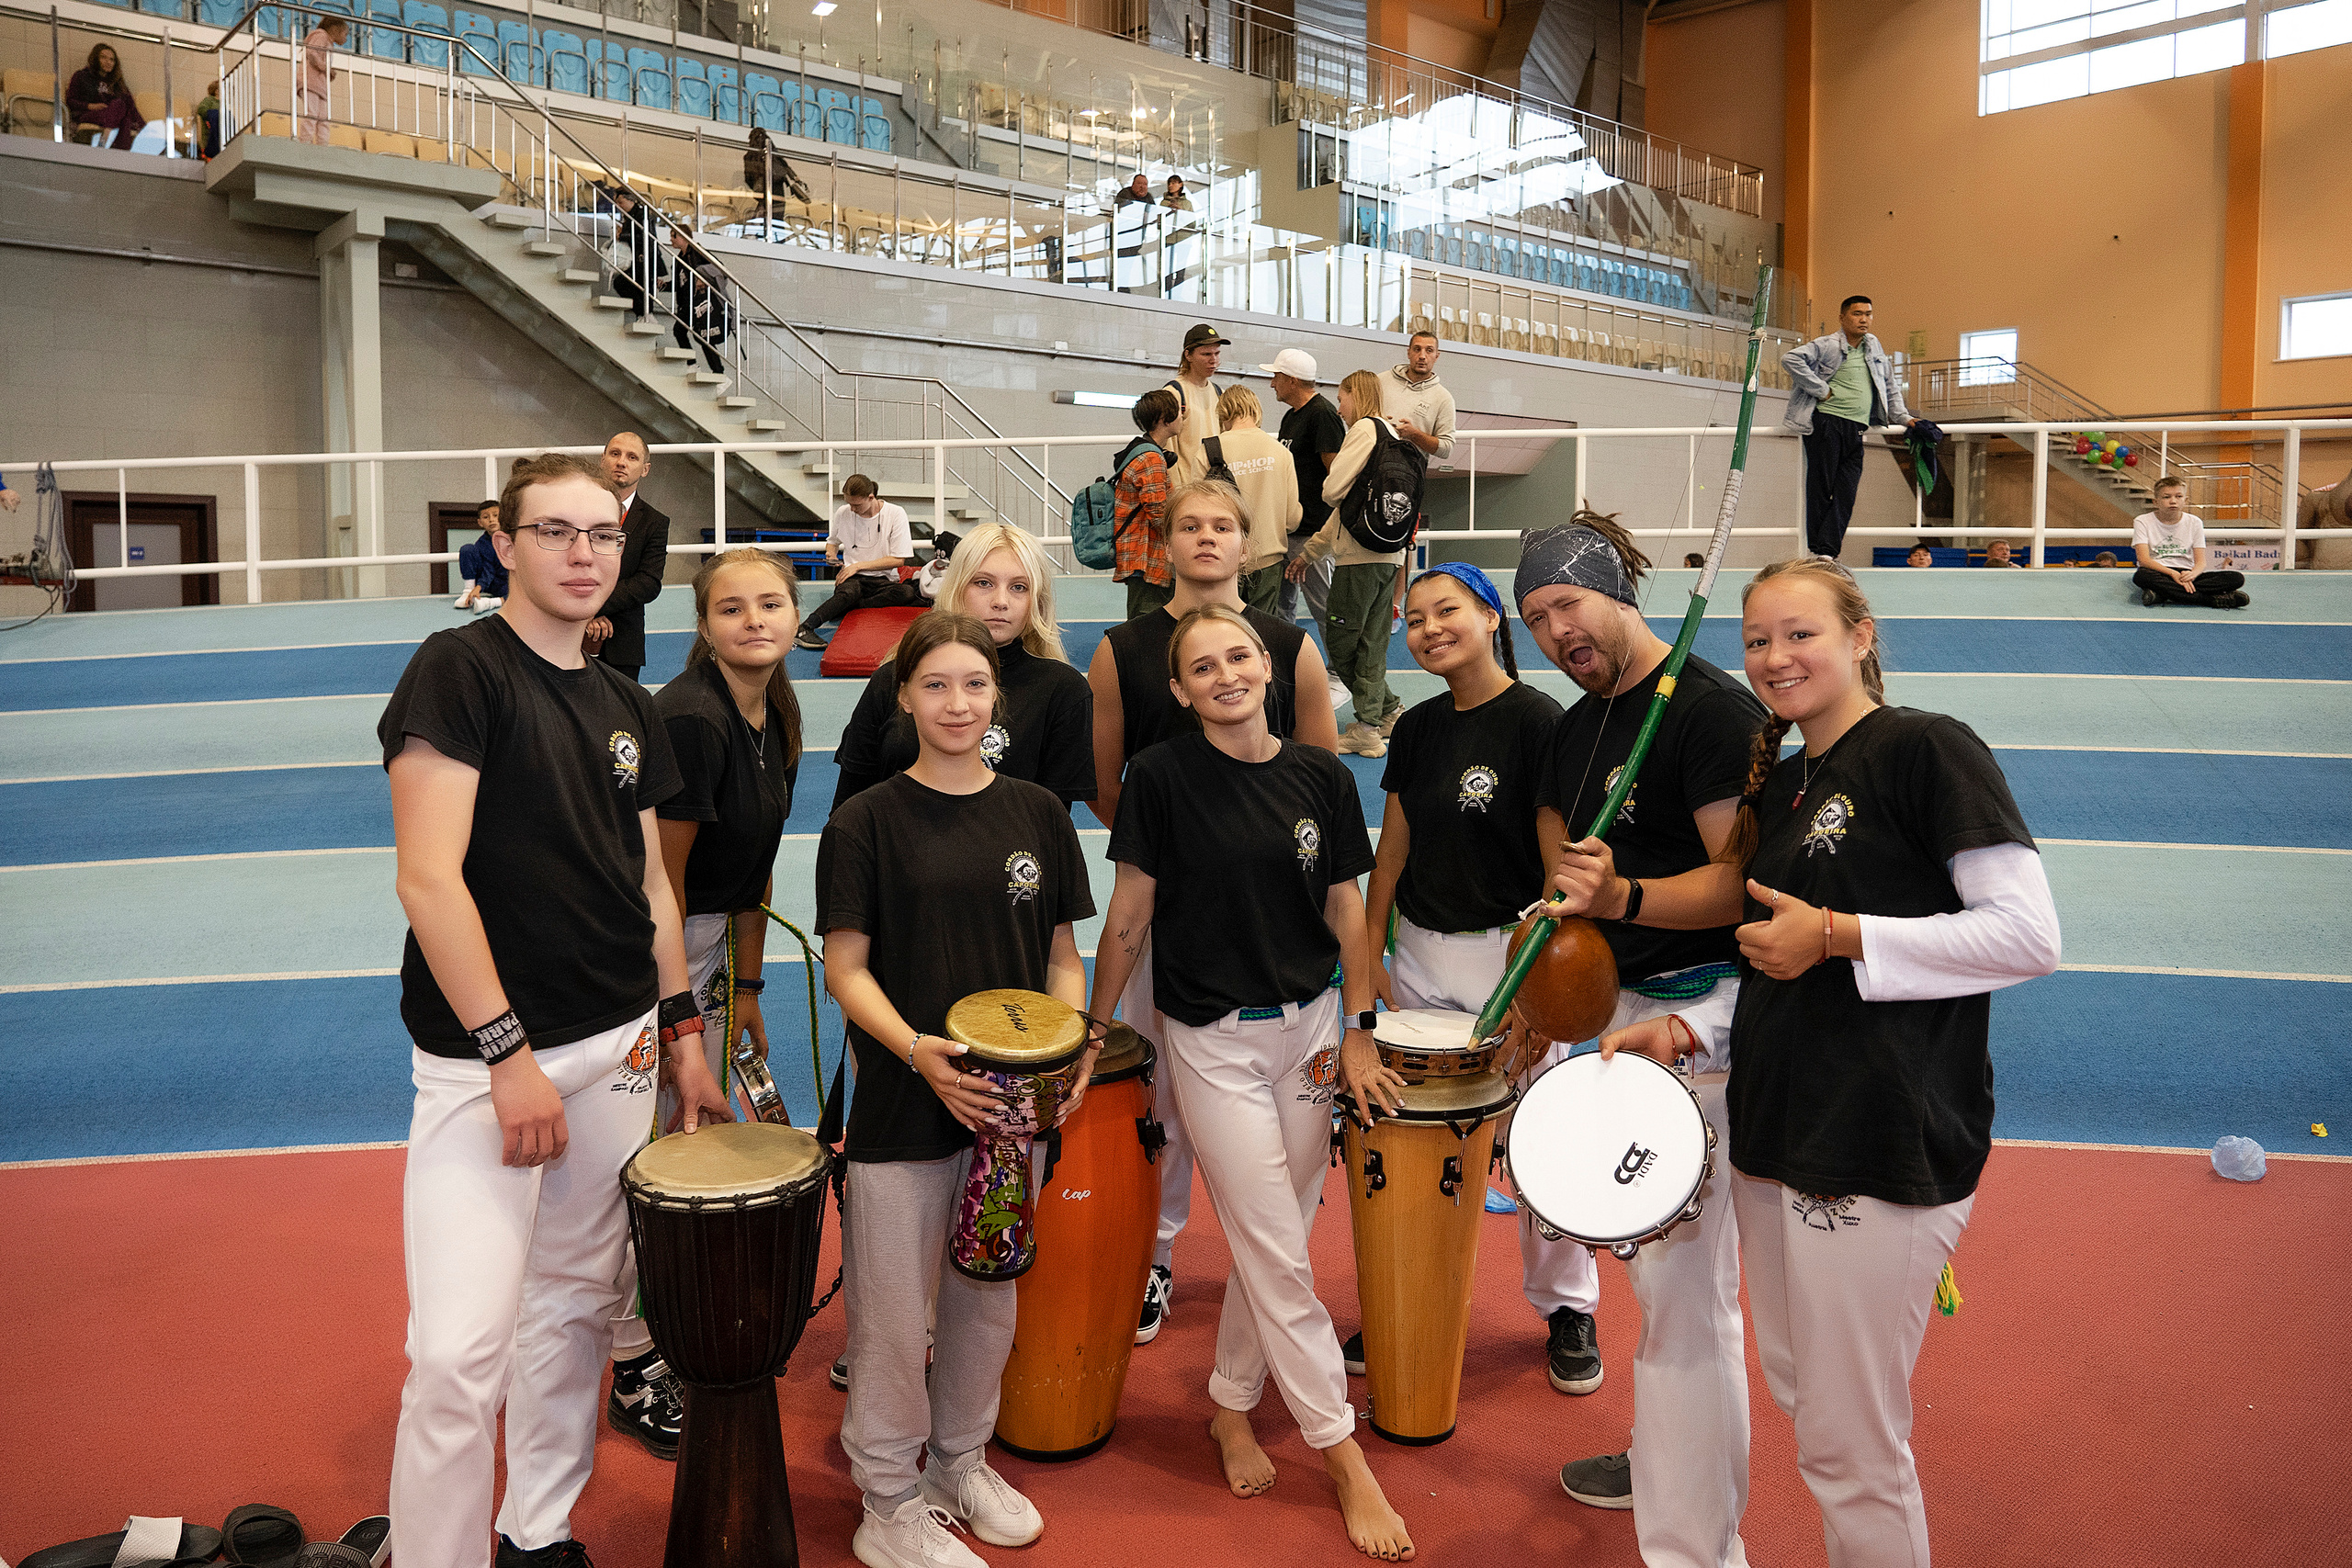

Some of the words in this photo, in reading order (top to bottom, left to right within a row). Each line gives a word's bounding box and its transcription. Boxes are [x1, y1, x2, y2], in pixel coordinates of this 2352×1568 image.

[1249, 466, 1274, 474] SCHOOL
[2214, 550, 2251, 558] Baikal
[979, 750, 1003, 761] OEIRA
[1458, 765, 1480, 784] CORDÃO
[1488, 769, 1498, 785] OURO
[1840, 795, 1855, 817] OURO
[1804, 828, 1847, 840] CAPOEIRA
[1004, 851, 1023, 872] CORDÃO
[473, 1011, 520, 1045] PARK
[1637, 1151, 1658, 1179] DADI
